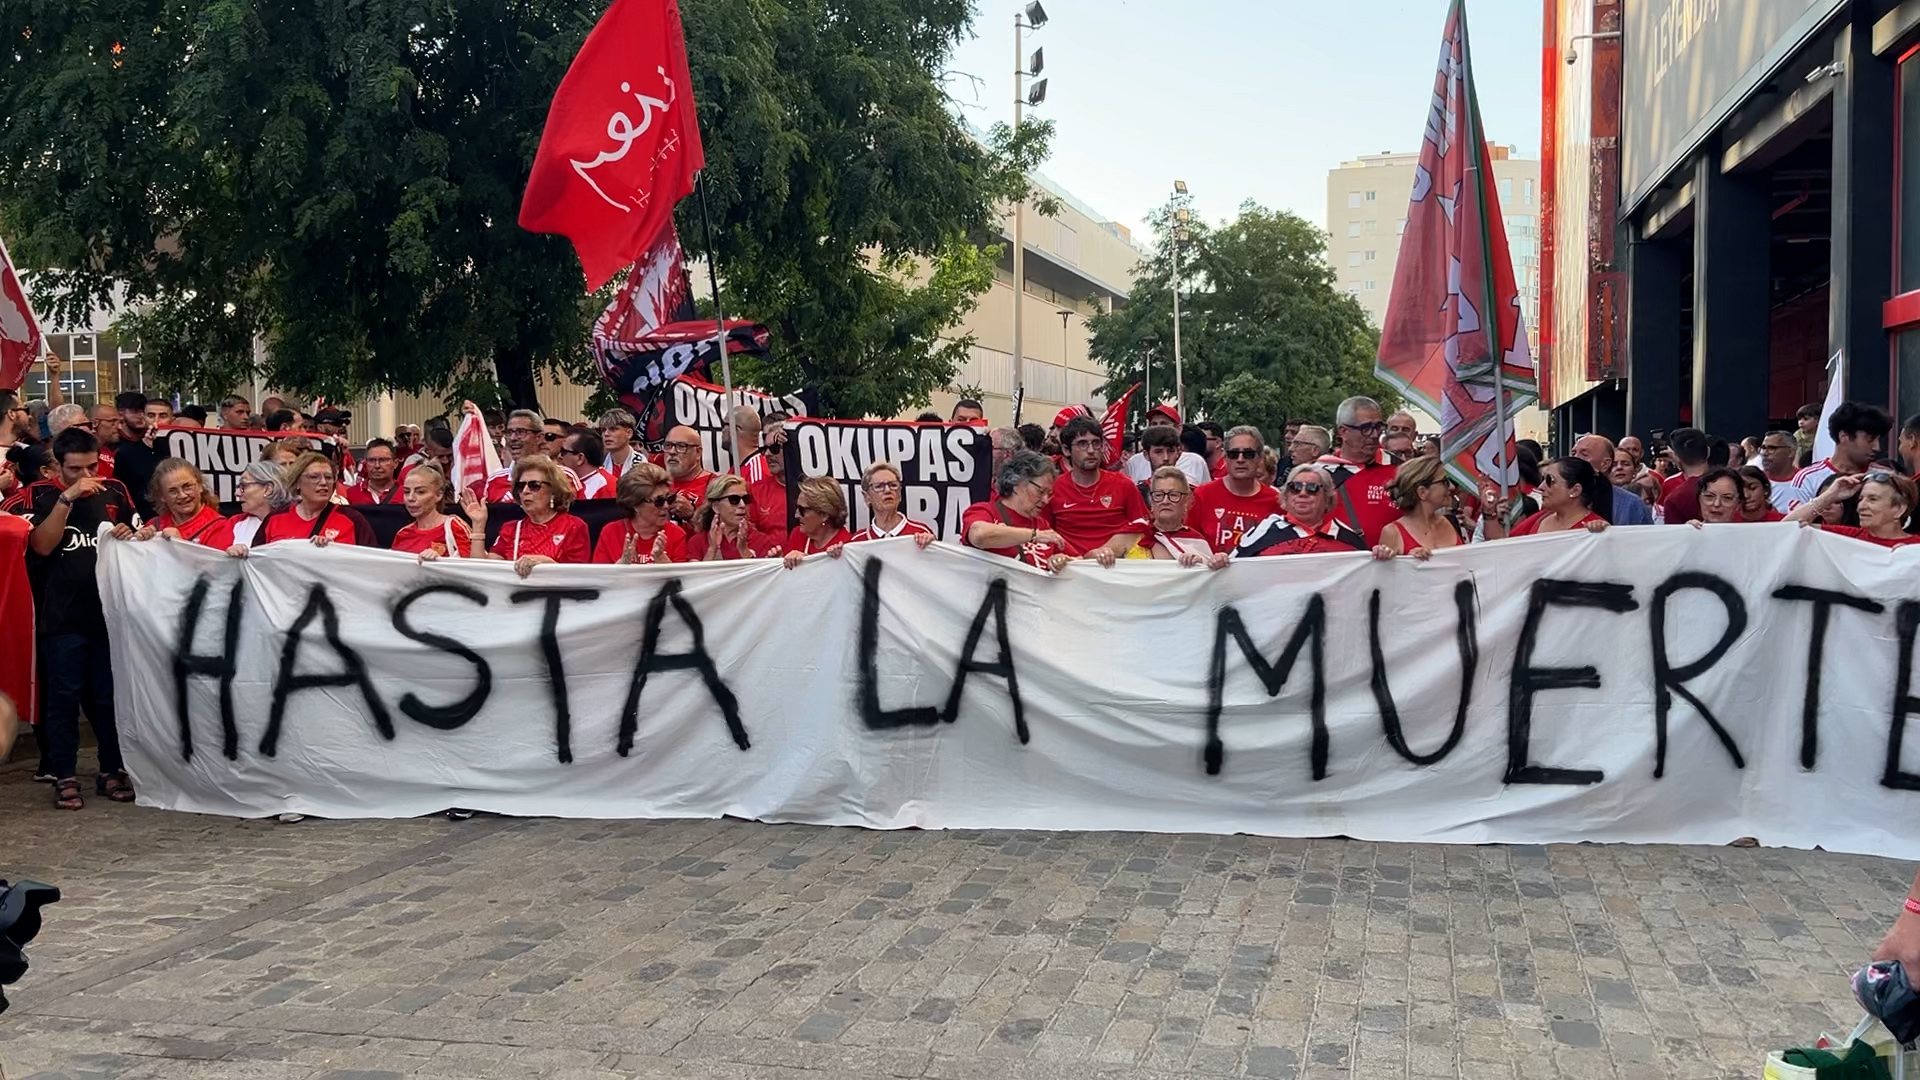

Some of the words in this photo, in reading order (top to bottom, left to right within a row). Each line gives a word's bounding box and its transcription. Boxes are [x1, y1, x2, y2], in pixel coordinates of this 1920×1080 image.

[168, 431, 323, 473] OKUP
[797, 424, 975, 483] OKUPAS
[173, 575, 751, 764] HASTA
[856, 554, 1031, 745] LA
